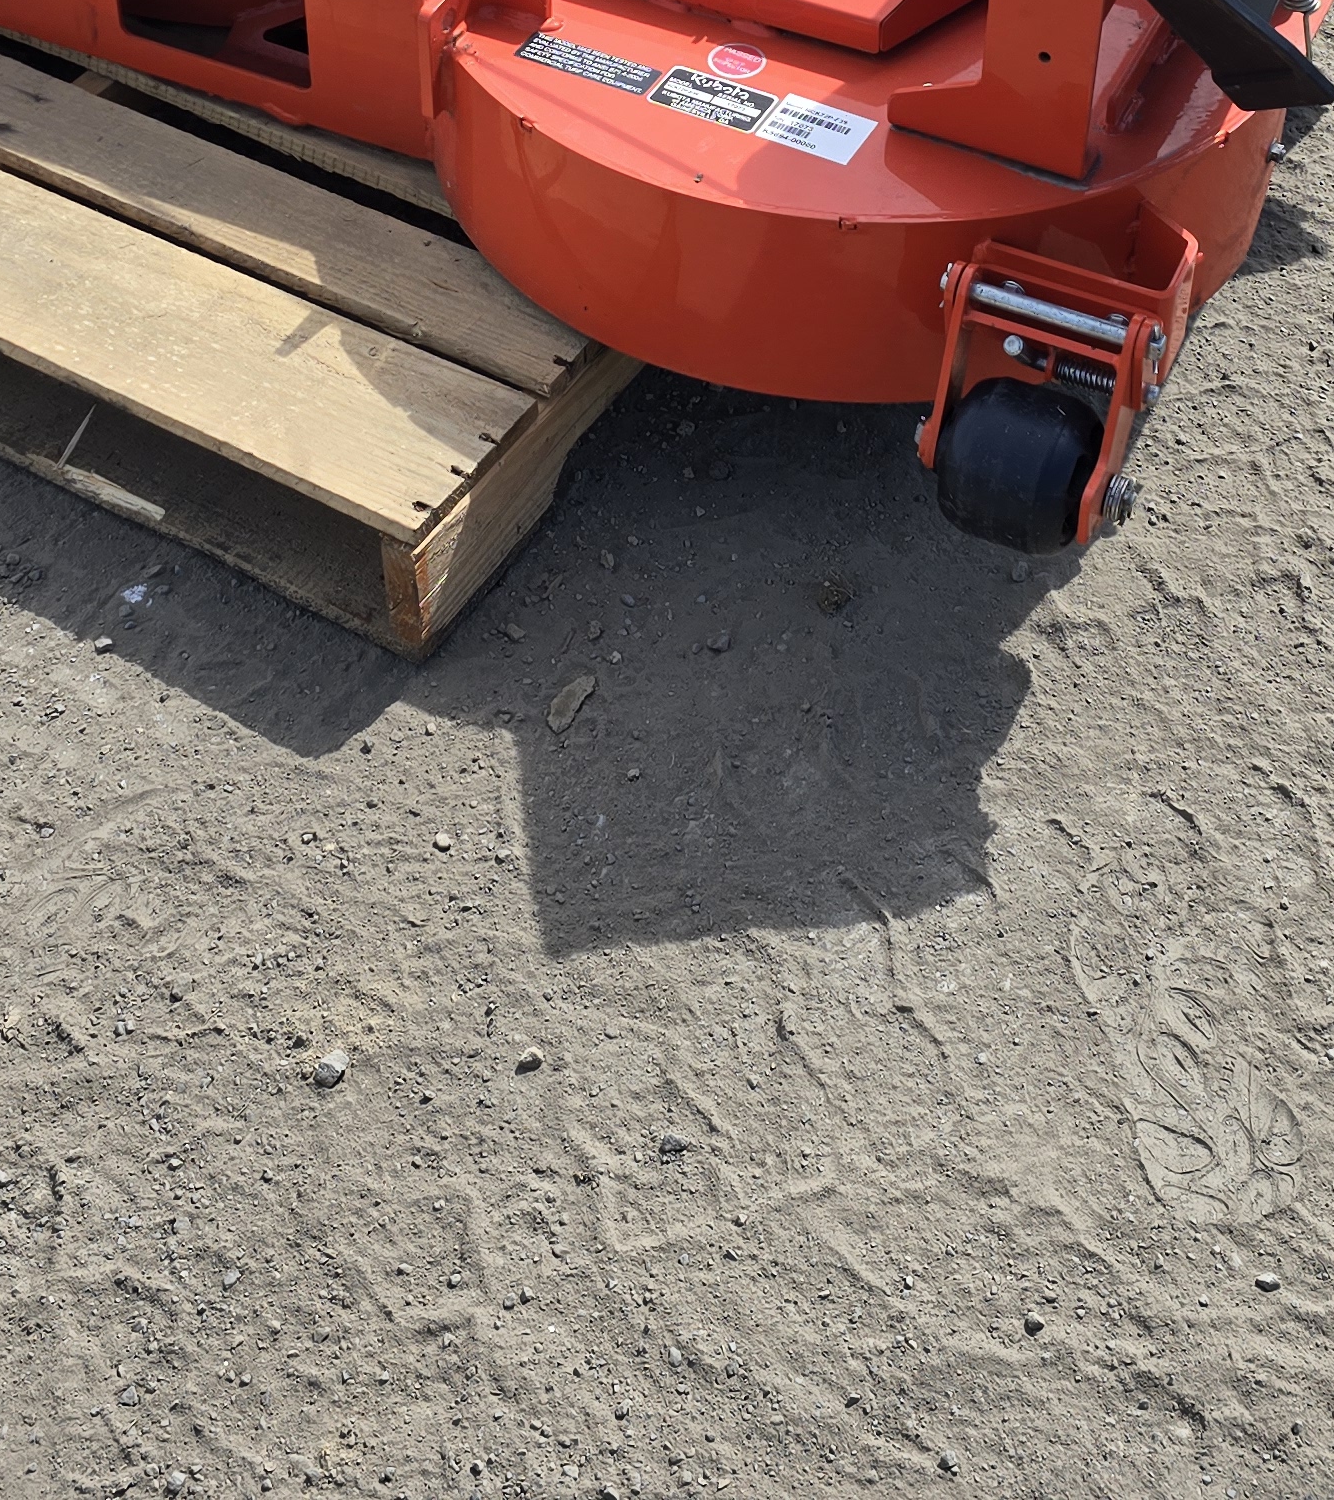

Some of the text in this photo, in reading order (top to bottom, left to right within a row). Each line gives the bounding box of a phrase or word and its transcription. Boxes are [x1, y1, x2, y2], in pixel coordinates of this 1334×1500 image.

[528, 41, 544, 49] AND
[532, 37, 572, 53] EVALUATED
[580, 52, 596, 60] THE
[594, 56, 651, 78] MANUFACTURER
[576, 45, 593, 53] HAS
[591, 50, 610, 59] BEEN
[610, 56, 637, 67] TESTED
[636, 64, 652, 72] AND
[519, 50, 564, 68] COMMERCIAL
[563, 64, 584, 74] TURF
[582, 70, 603, 80] CARE
[523, 46, 552, 57] SAFETY
[599, 70, 616, 78] FOR
[668, 76, 694, 87] MODEL
[690, 72, 750, 100] Kubota
